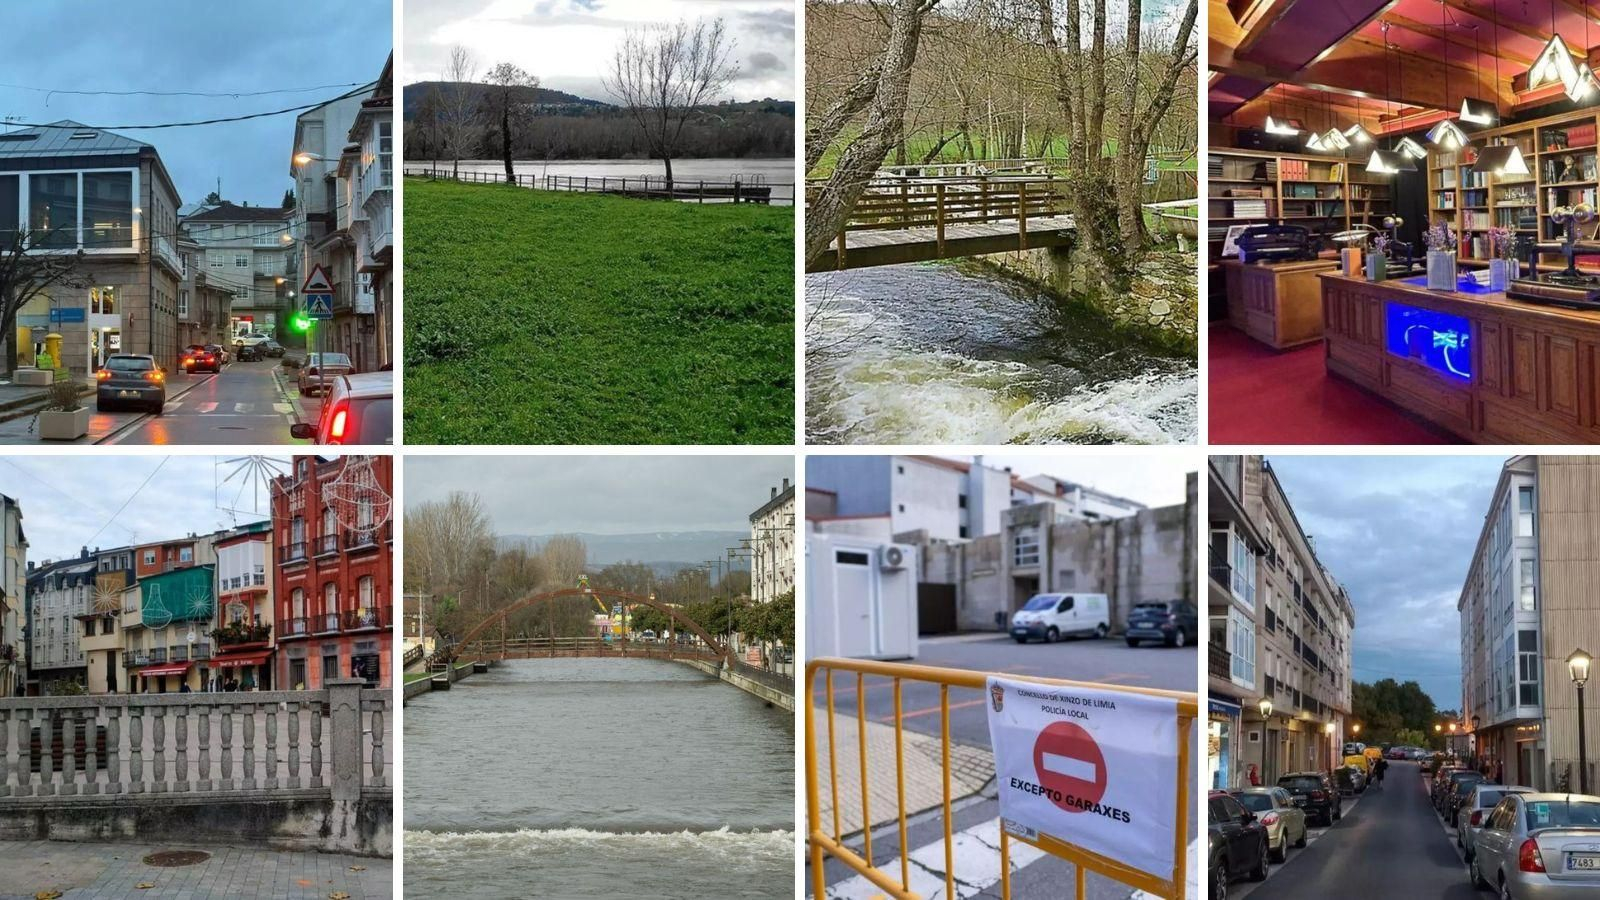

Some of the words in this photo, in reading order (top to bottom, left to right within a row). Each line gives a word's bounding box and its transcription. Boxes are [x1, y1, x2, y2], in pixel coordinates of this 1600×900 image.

[1049, 694, 1058, 702] DE
[1060, 695, 1081, 705] XINZO
[1082, 698, 1092, 707] DE
[1094, 700, 1116, 710] LIMIA
[1041, 704, 1066, 716] POLICÍA
[1068, 710, 1089, 720] LOCAL
[1010, 777, 1062, 802] EXCEPTO
[1065, 795, 1131, 823] GARAXES
[1572, 858, 1594, 868] 7483
